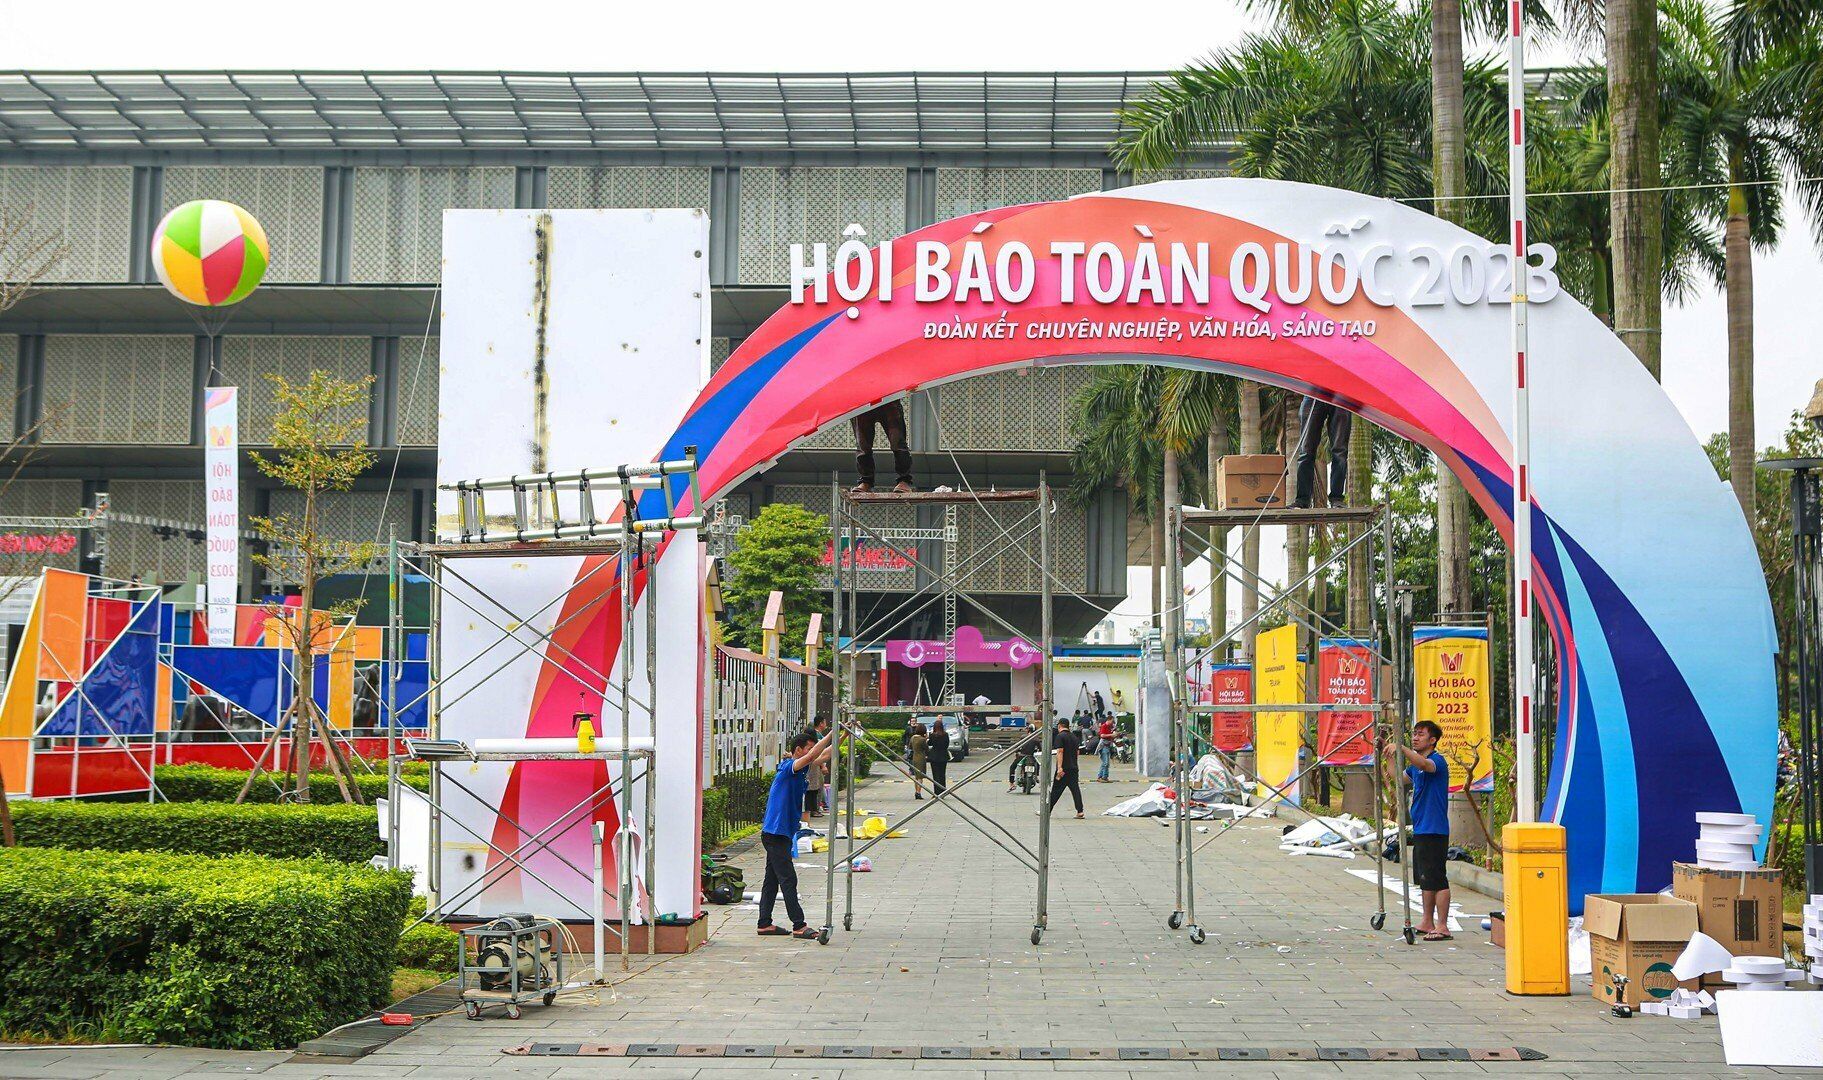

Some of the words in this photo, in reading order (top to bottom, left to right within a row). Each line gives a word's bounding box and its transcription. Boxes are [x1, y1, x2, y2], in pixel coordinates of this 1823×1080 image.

[789, 222, 894, 321] HỘI
[914, 221, 1036, 303] BÁO
[1050, 224, 1210, 304] TOÀN
[1229, 217, 1395, 314] QUỐC
[1410, 243, 1561, 308] 2023
[923, 314, 977, 339] ĐOÀN
[981, 310, 1018, 339] KẾT
[1026, 317, 1102, 339] CHUYÊN
[1107, 317, 1182, 342] NGHIỆP,
[1188, 315, 1227, 339] VĂN
[1231, 313, 1277, 341] HÓA,
[1281, 311, 1335, 338] SÁNG
[1339, 319, 1377, 341] TẠO
[1329, 677, 1346, 687] HỘI
[1347, 676, 1366, 686] BÁO
[1429, 677, 1450, 690] HỘI
[1452, 677, 1476, 688] BÁO
[1347, 686, 1367, 695] QUỐC
[1427, 689, 1451, 699] TOÀN
[1453, 690, 1478, 700] QUỐC
[1334, 697, 1361, 705] 2023
[1436, 703, 1469, 714] 2023
